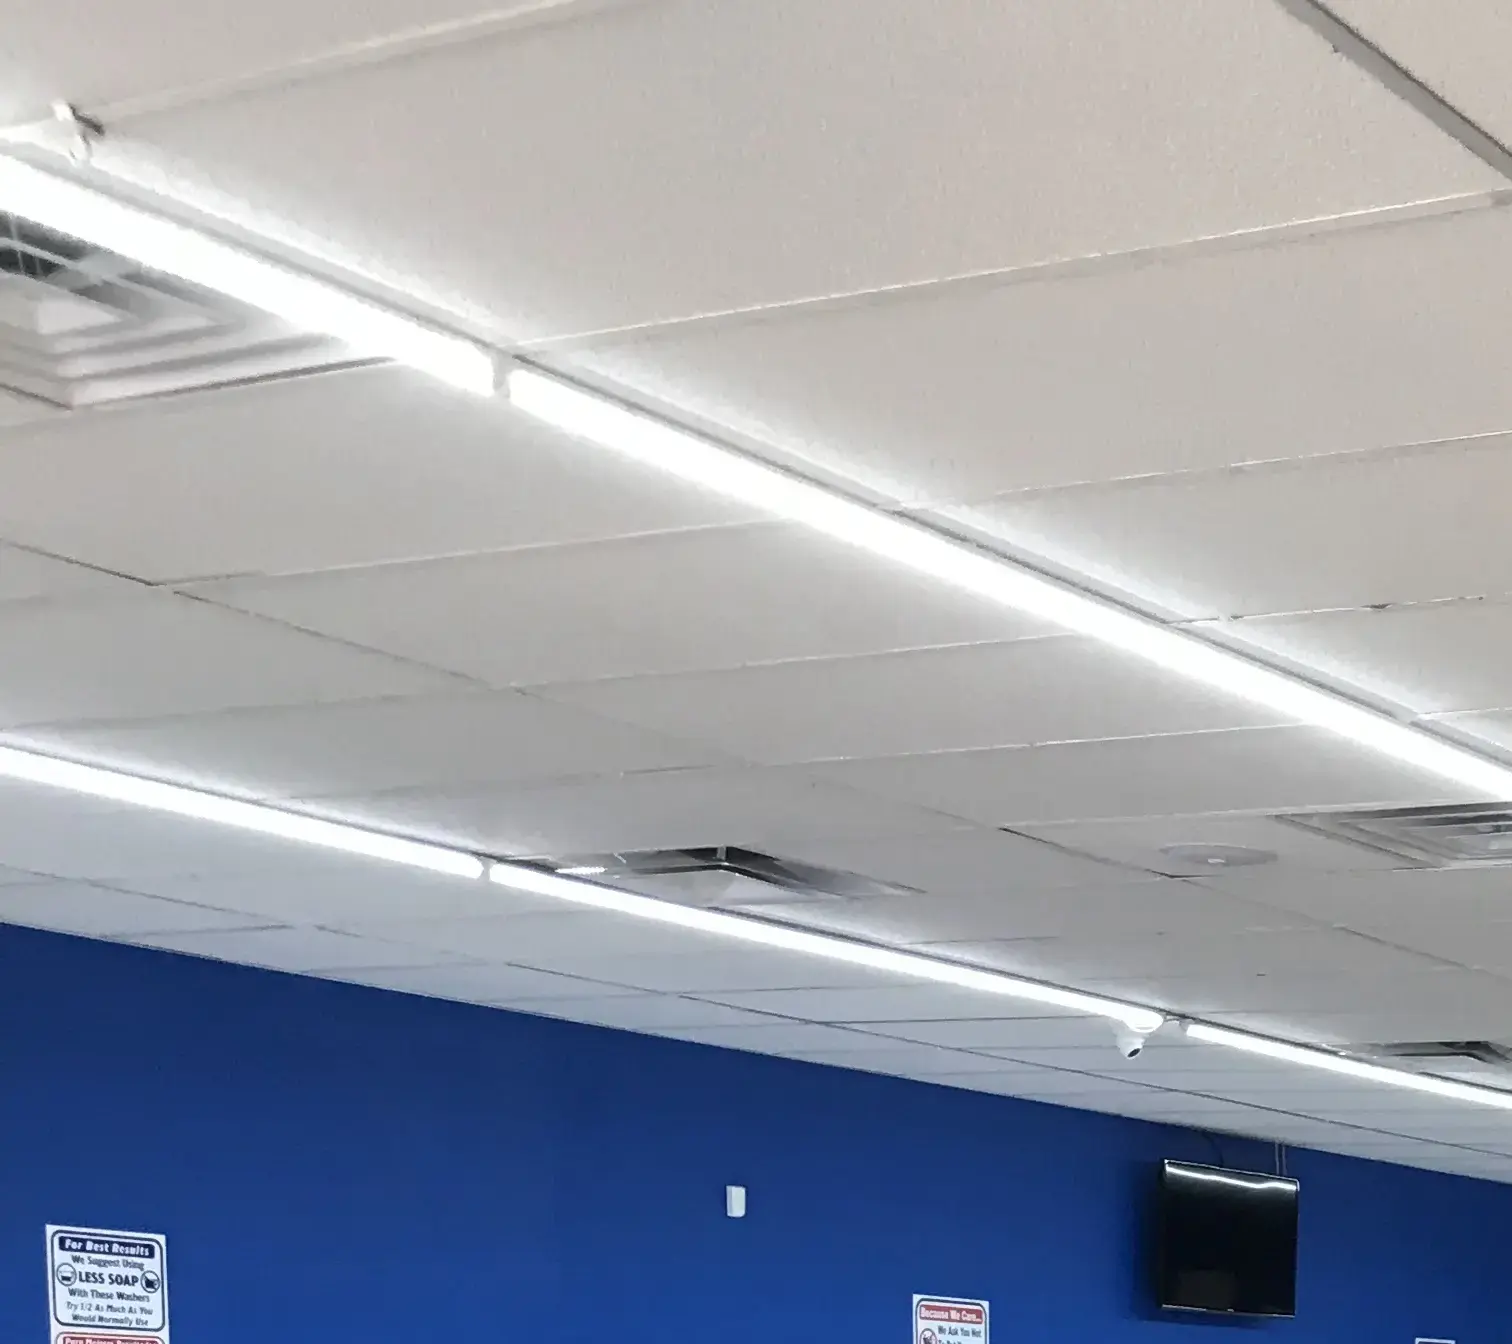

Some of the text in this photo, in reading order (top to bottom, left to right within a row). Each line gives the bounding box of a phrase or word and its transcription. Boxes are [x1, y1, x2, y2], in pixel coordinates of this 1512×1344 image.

[64, 1238, 150, 1256] For Best Results
[70, 1254, 145, 1271] We Suggest Using
[79, 1271, 139, 1287] LESS SOAP
[68, 1288, 150, 1302] With These Washers
[66, 1301, 78, 1312] Try
[106, 1303, 126, 1313] Much
[139, 1306, 153, 1316] You
[72, 1313, 149, 1327] Would Normally Use
